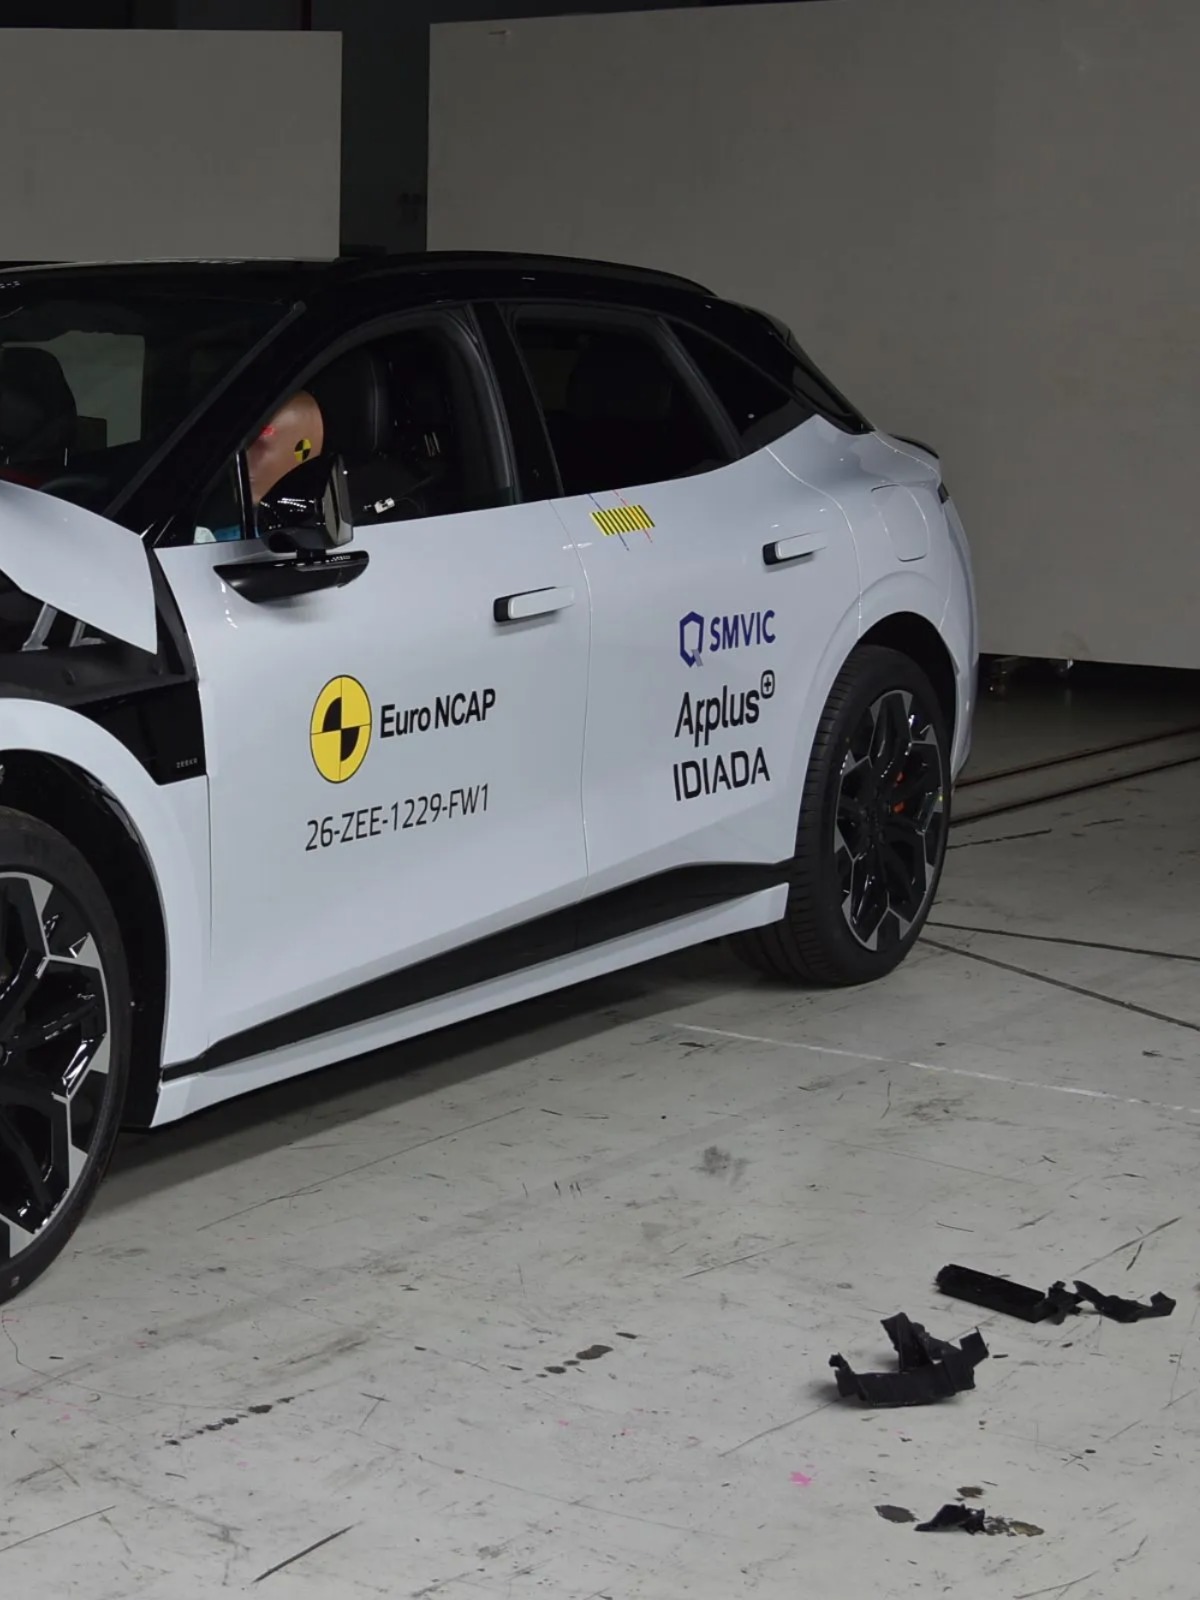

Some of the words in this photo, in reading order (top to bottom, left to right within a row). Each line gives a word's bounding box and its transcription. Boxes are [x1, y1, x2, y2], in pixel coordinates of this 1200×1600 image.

[709, 609, 776, 652] SMVIC
[380, 703, 431, 738] Euro
[434, 688, 496, 729] NCAP
[673, 747, 770, 801] IDIADA
[305, 783, 489, 851] 26-ZEE-1229-FW1
